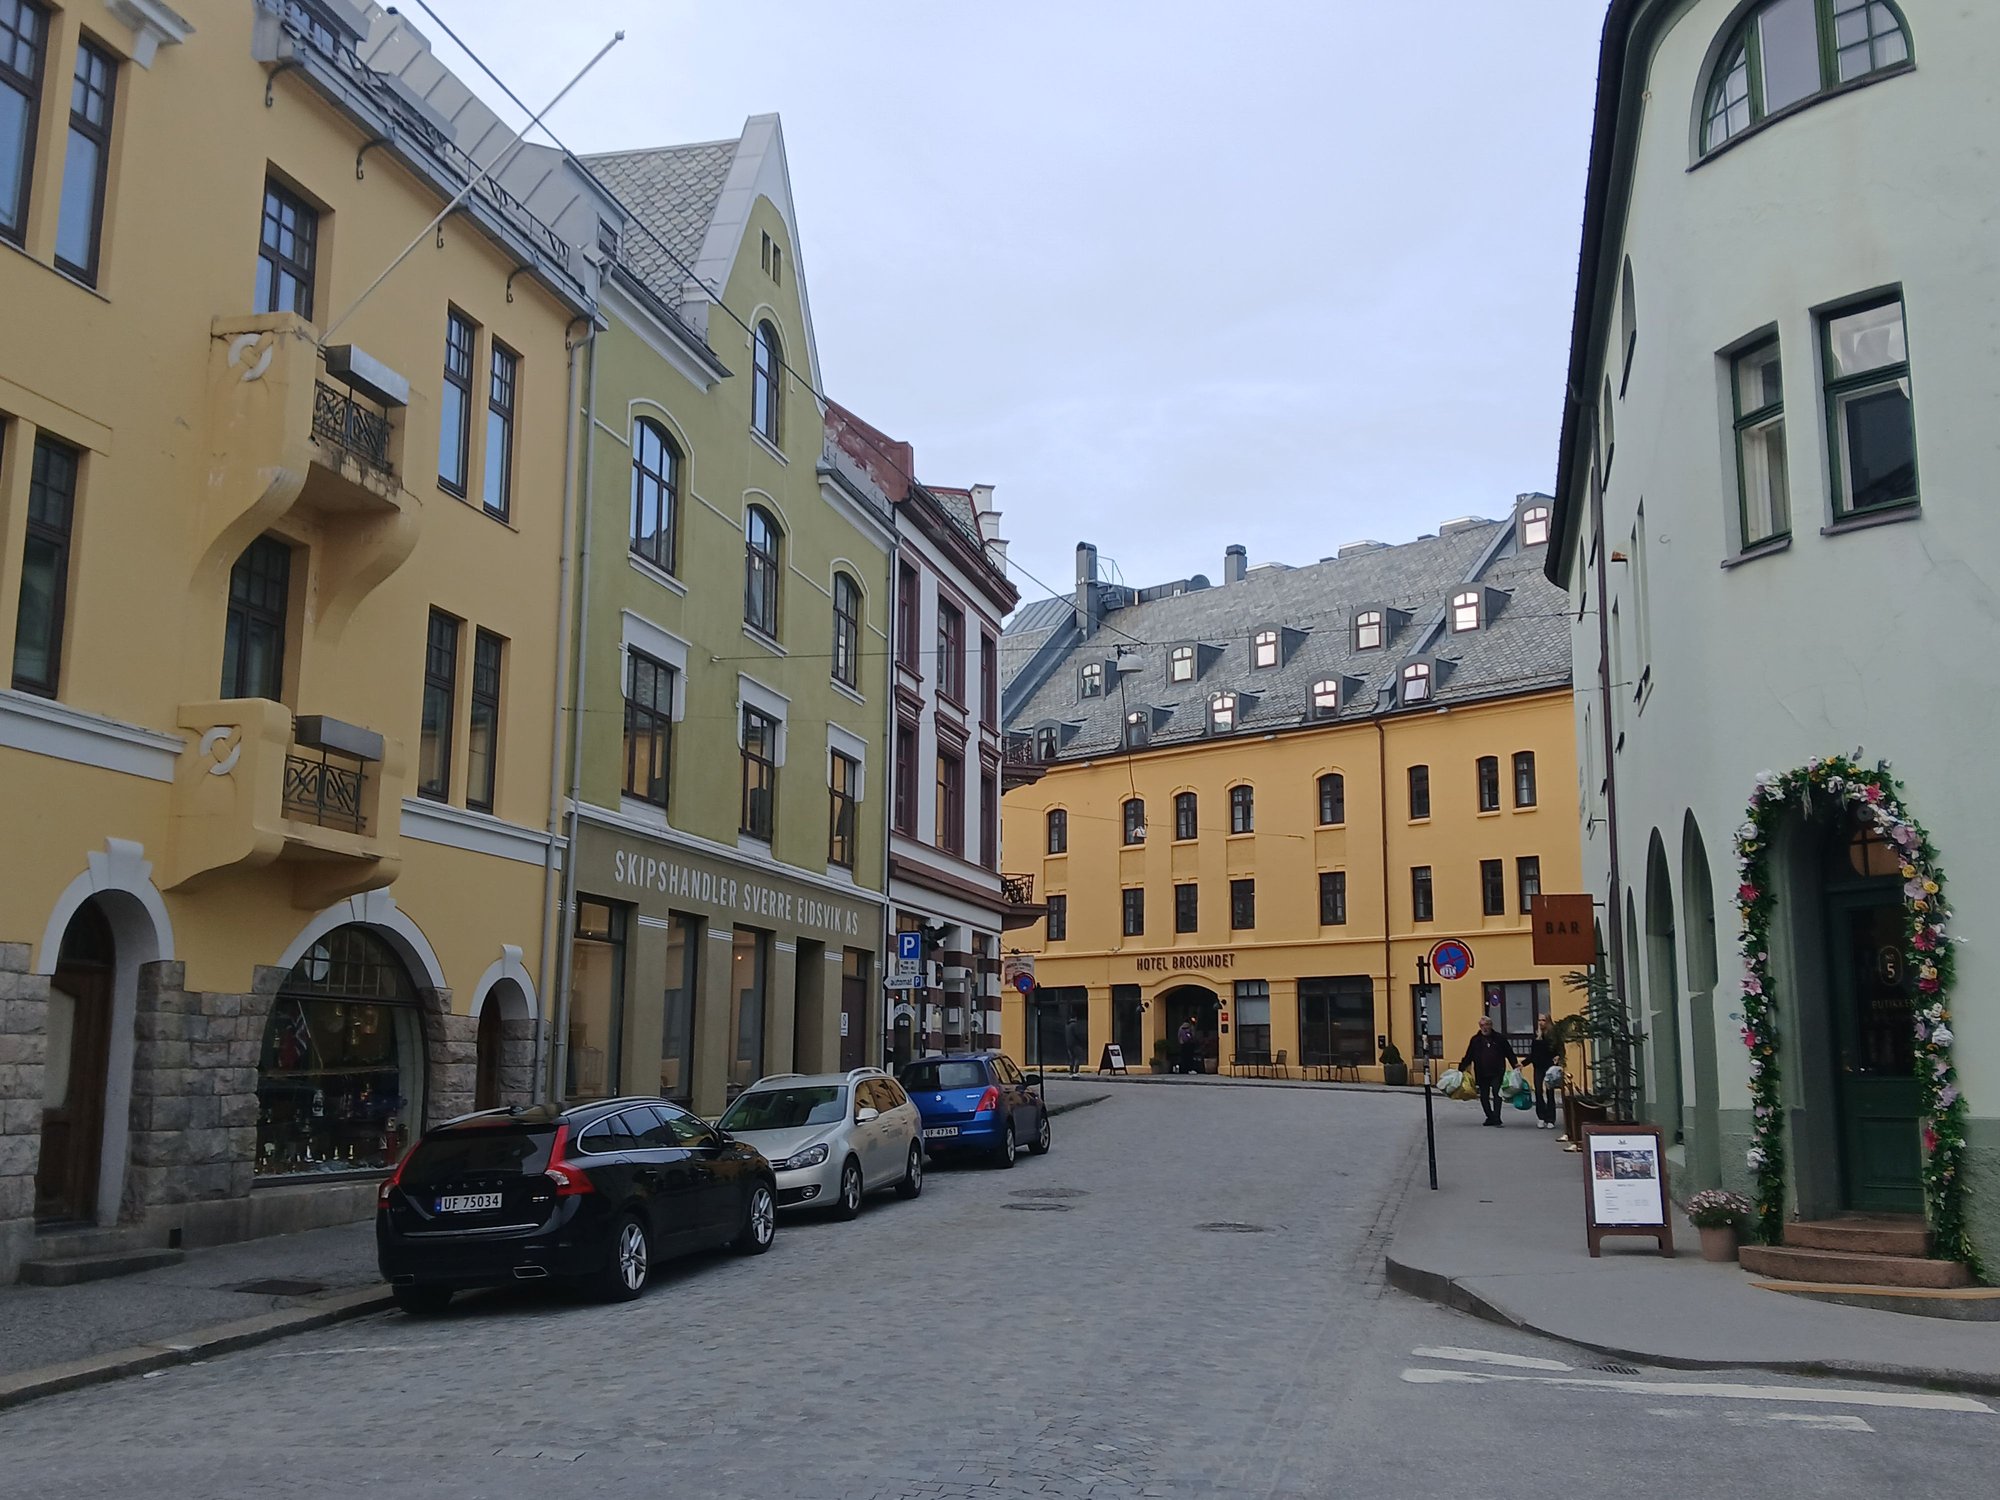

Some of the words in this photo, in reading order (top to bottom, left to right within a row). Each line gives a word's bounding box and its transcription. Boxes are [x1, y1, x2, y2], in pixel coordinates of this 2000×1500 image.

[614, 849, 737, 909] SKIPSHANDLER
[743, 883, 792, 921] SVERRE
[797, 898, 842, 932] EIDSVIK
[845, 910, 859, 936] AS
[1546, 922, 1579, 934] BAR
[904, 937, 915, 955] P
[1137, 957, 1168, 971] HOTEL
[1172, 953, 1235, 969] BROSUNDET
[1887, 963, 1895, 978] 5
[444, 1197, 458, 1210] UF
[463, 1195, 499, 1208] 75034
